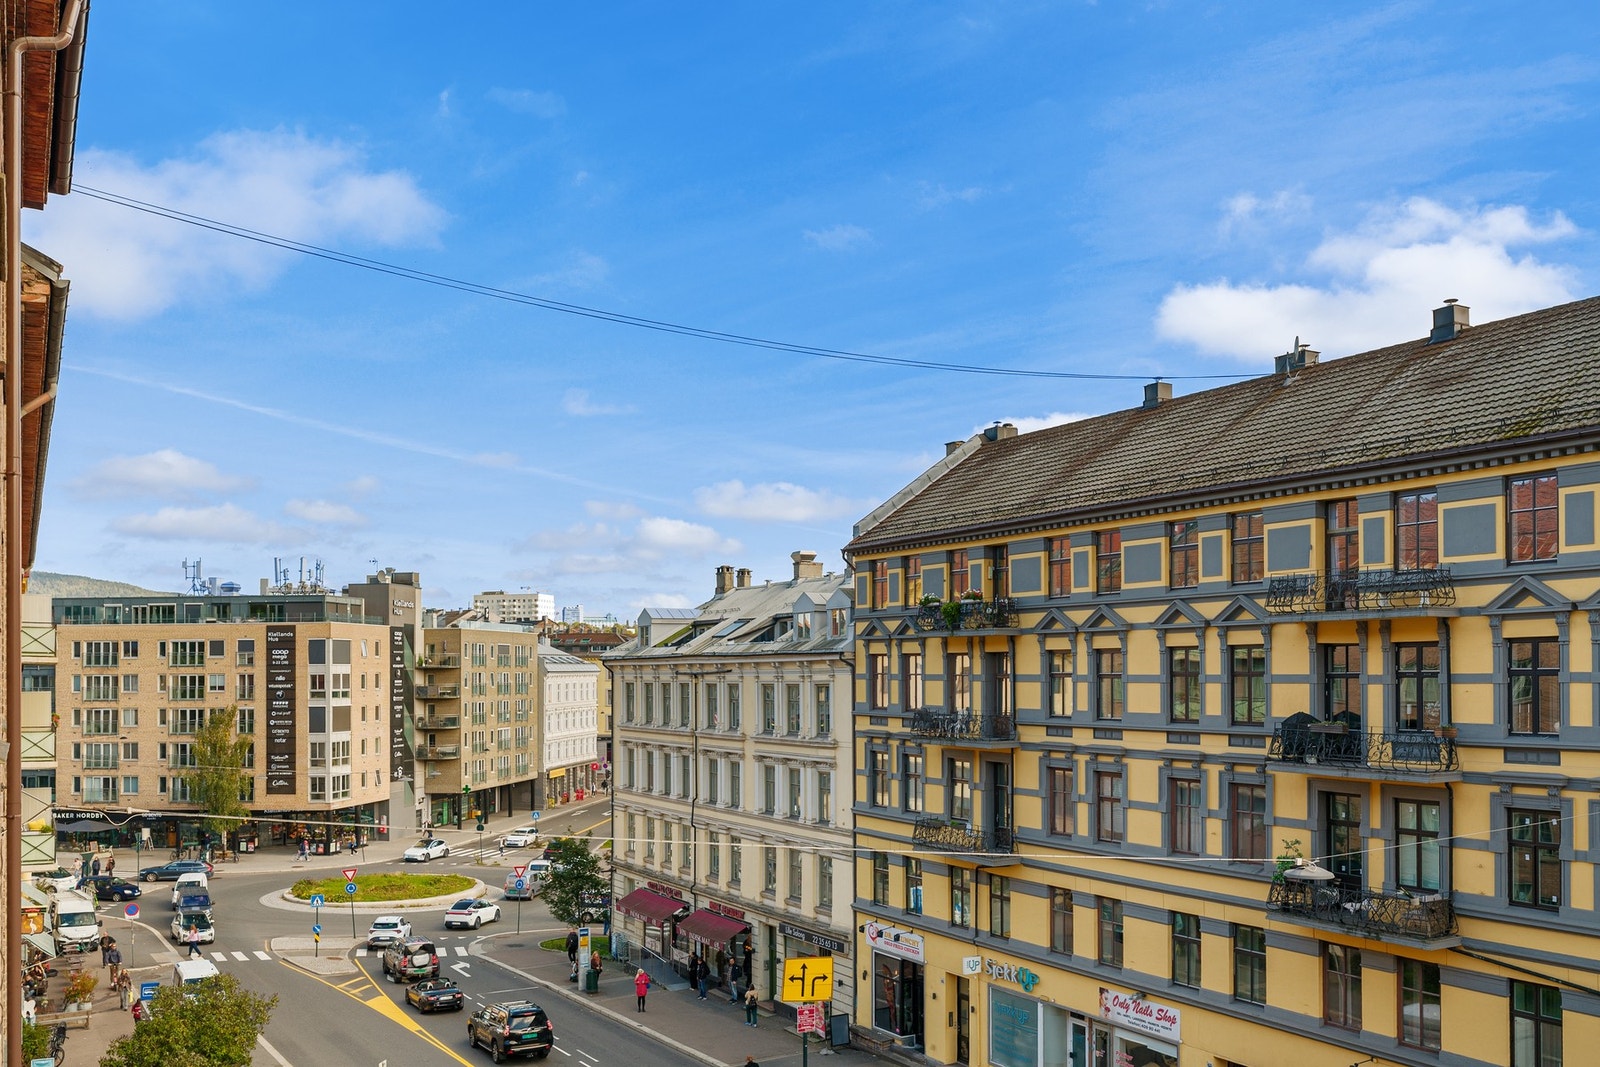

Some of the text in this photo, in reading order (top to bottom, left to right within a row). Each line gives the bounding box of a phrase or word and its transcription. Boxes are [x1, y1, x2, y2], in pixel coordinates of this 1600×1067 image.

[1113, 995, 1131, 1013] Only
[1131, 1000, 1153, 1018] Nails
[1155, 1007, 1177, 1027] Shop
